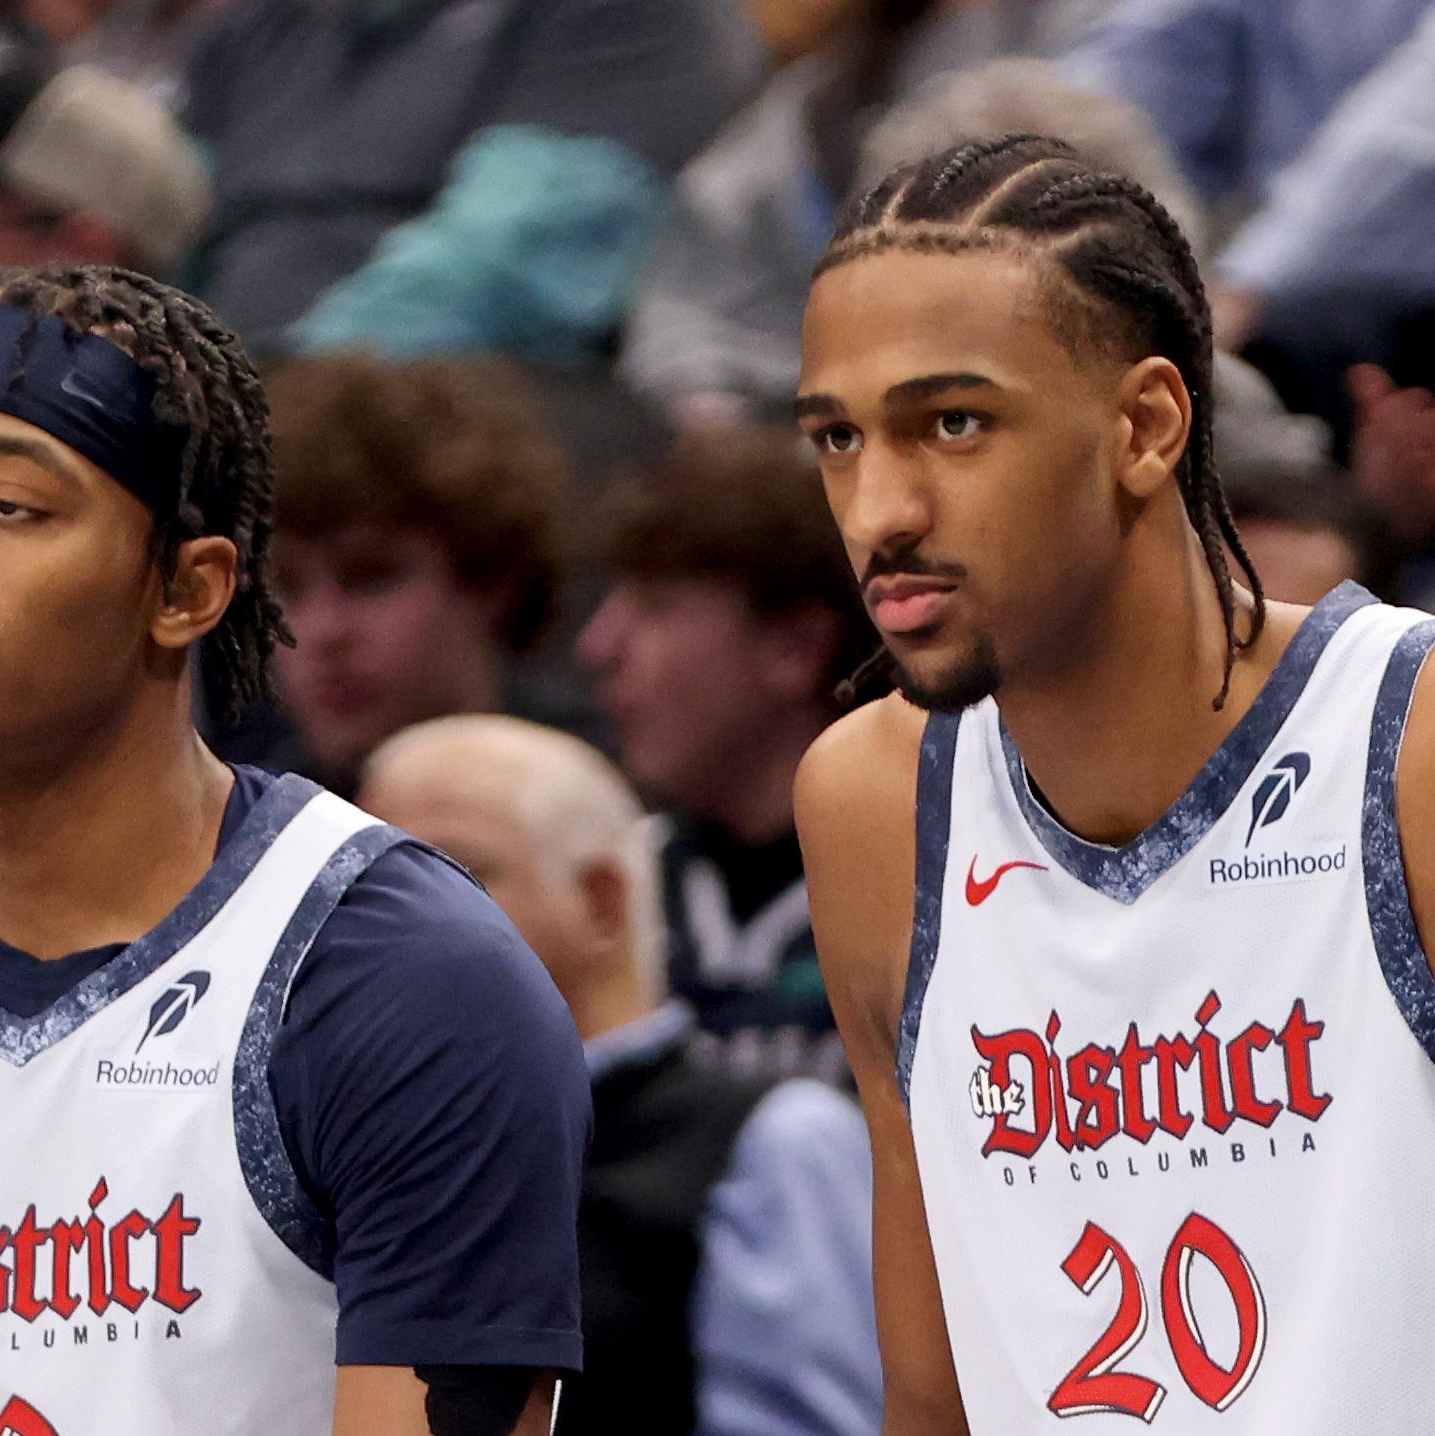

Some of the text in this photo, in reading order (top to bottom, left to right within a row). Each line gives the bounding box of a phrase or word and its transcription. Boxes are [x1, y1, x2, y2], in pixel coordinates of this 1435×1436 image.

[1210, 845, 1346, 884] Robinhood
[96, 1060, 219, 1087] Robinhood
[970, 988, 1333, 1158] District
[970, 1066, 1024, 1117] the
[1003, 1132, 1316, 1186] OF COLUMBIA
[1047, 1211, 1267, 1424] 20
